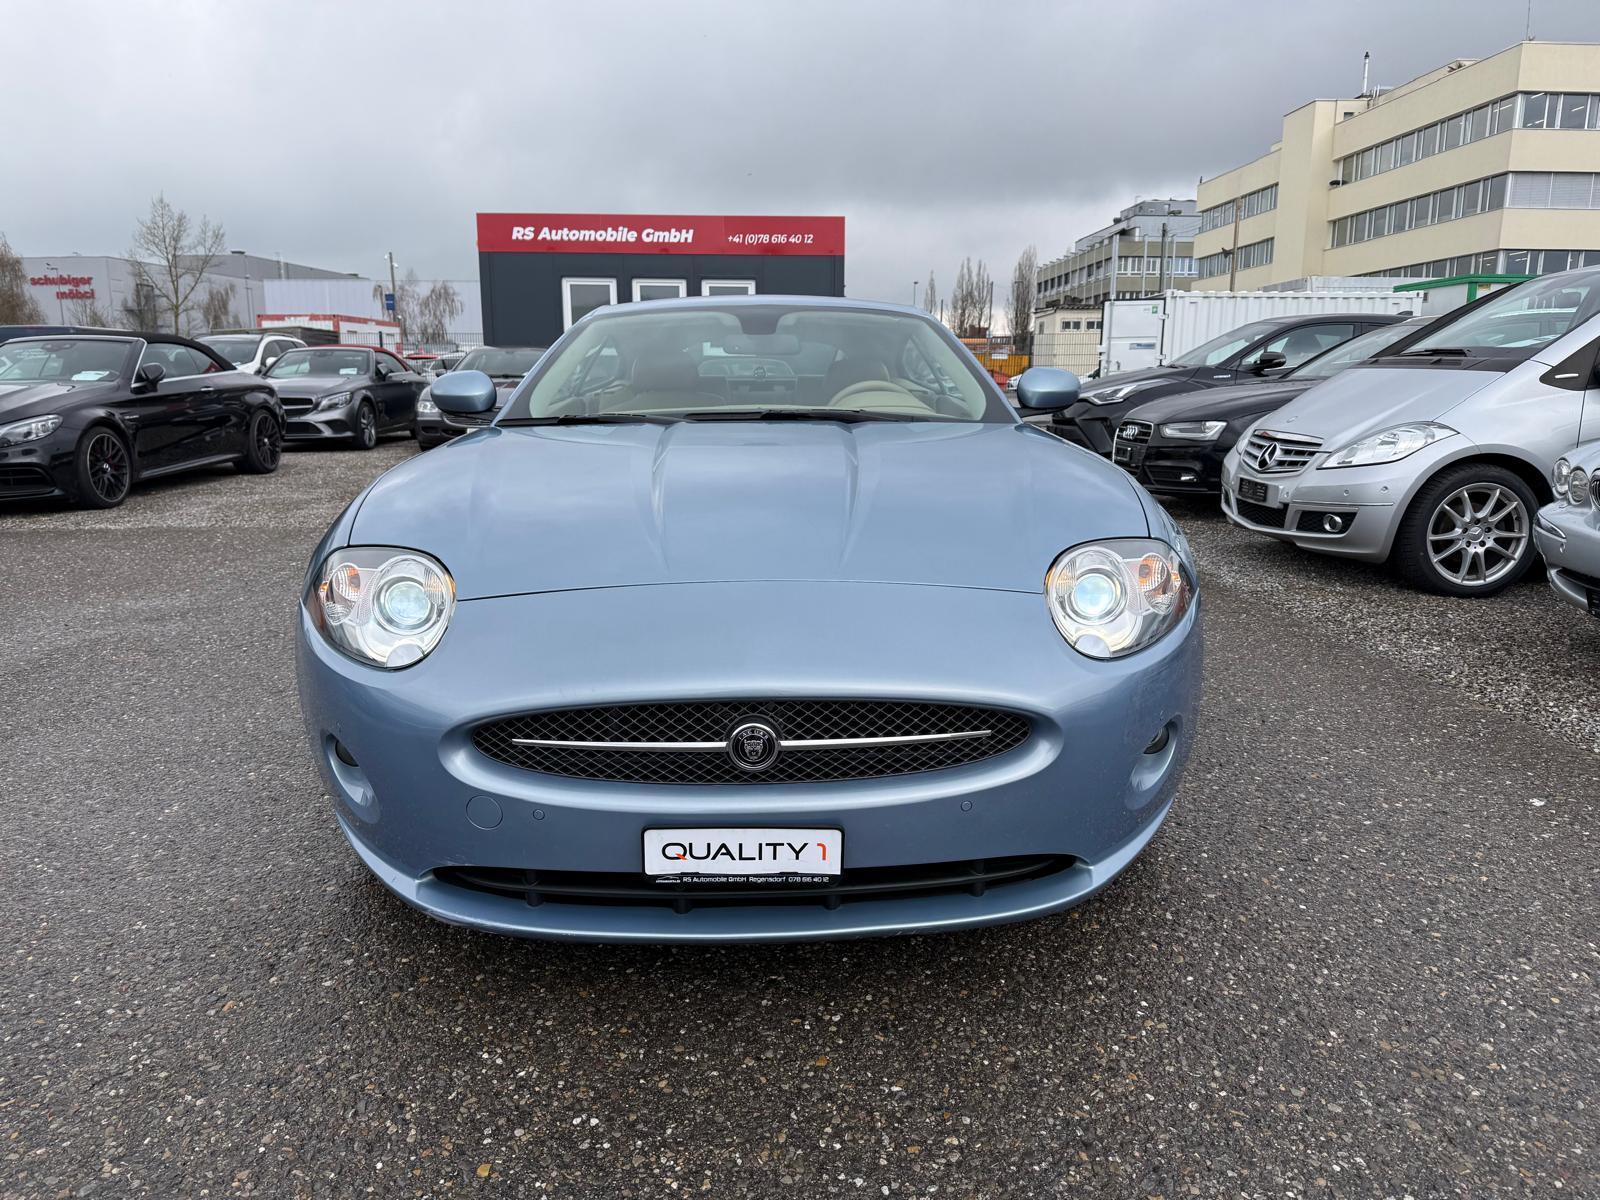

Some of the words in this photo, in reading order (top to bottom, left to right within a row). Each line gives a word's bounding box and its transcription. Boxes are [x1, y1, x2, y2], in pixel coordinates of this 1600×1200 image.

[512, 226, 535, 241] RS
[537, 226, 638, 242] Automobile
[641, 228, 694, 243] GmbH
[728, 234, 743, 244] +41
[745, 233, 770, 245] (0)78
[771, 234, 787, 244] 616
[788, 234, 802, 244] 40
[804, 234, 814, 244] 12
[30, 275, 93, 288] schubiger
[661, 842, 809, 861] QUALITY
[816, 842, 827, 861] 1
[748, 876, 786, 884] Regensdorf
